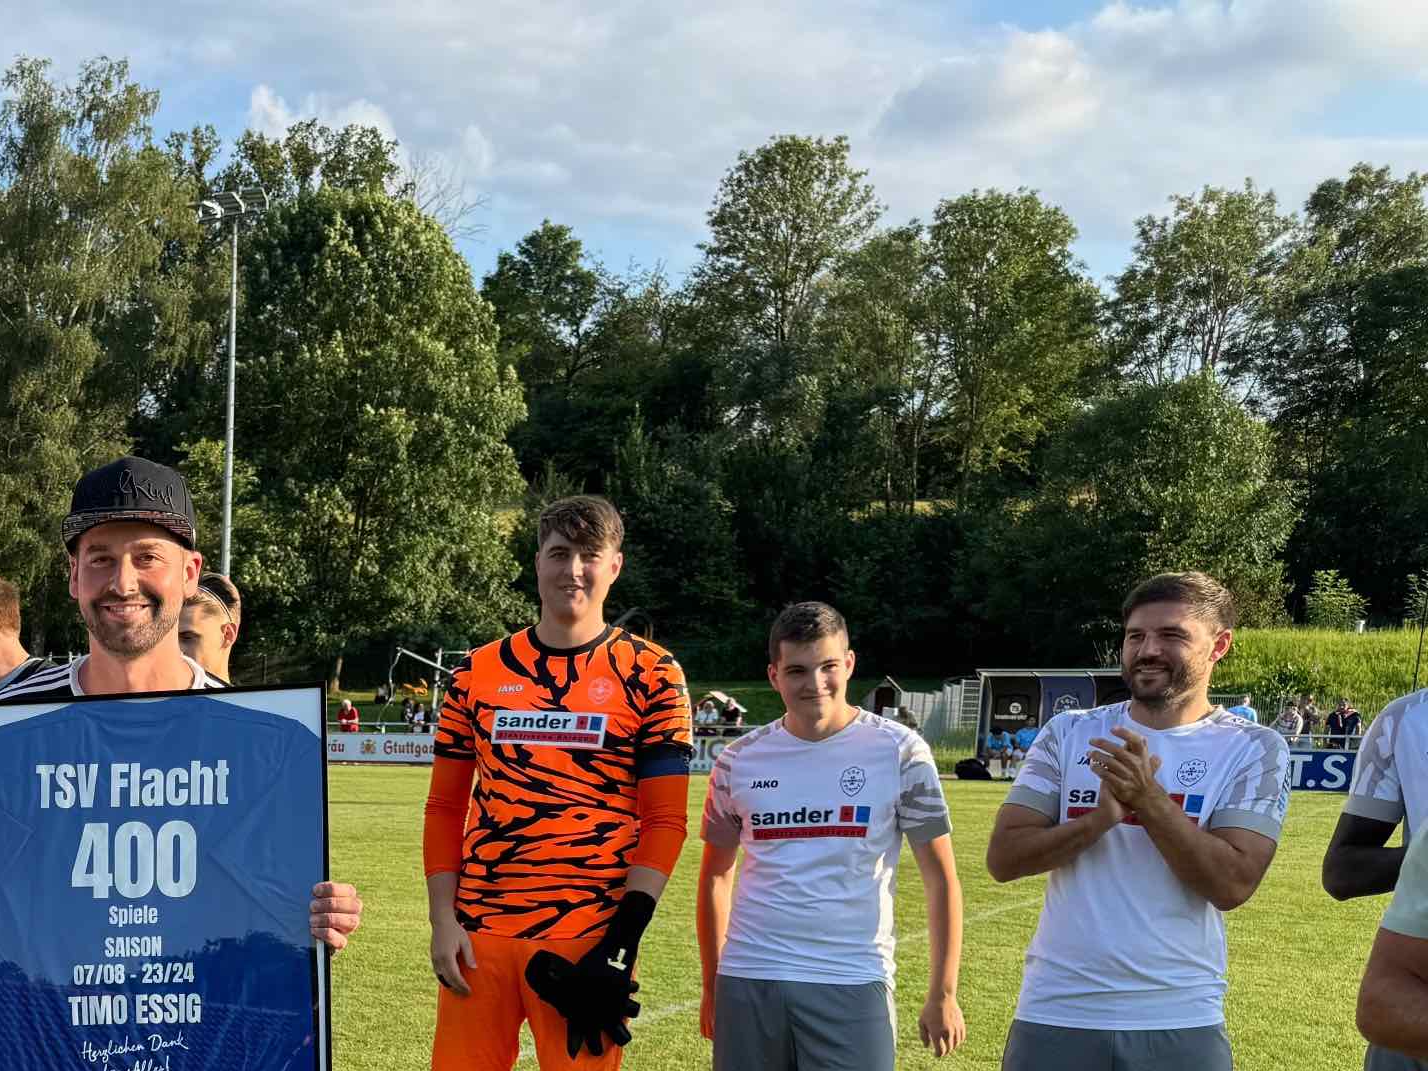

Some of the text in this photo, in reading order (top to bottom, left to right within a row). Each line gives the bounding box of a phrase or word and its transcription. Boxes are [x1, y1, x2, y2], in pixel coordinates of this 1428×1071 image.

[497, 684, 524, 694] JAKO
[496, 714, 572, 730] sander
[35, 759, 230, 809] TSV Flacht
[750, 780, 779, 789] JAKO
[1068, 788, 1099, 804] sa
[751, 806, 834, 827] sander
[71, 820, 198, 899] 400
[108, 904, 159, 928] Spiele
[104, 935, 162, 958] SAISON
[73, 963, 126, 986] 07/08
[141, 961, 195, 984] 23/24
[68, 993, 202, 1026] TIMO ESSIG
[82, 1031, 189, 1062] Herzlichen Dank
